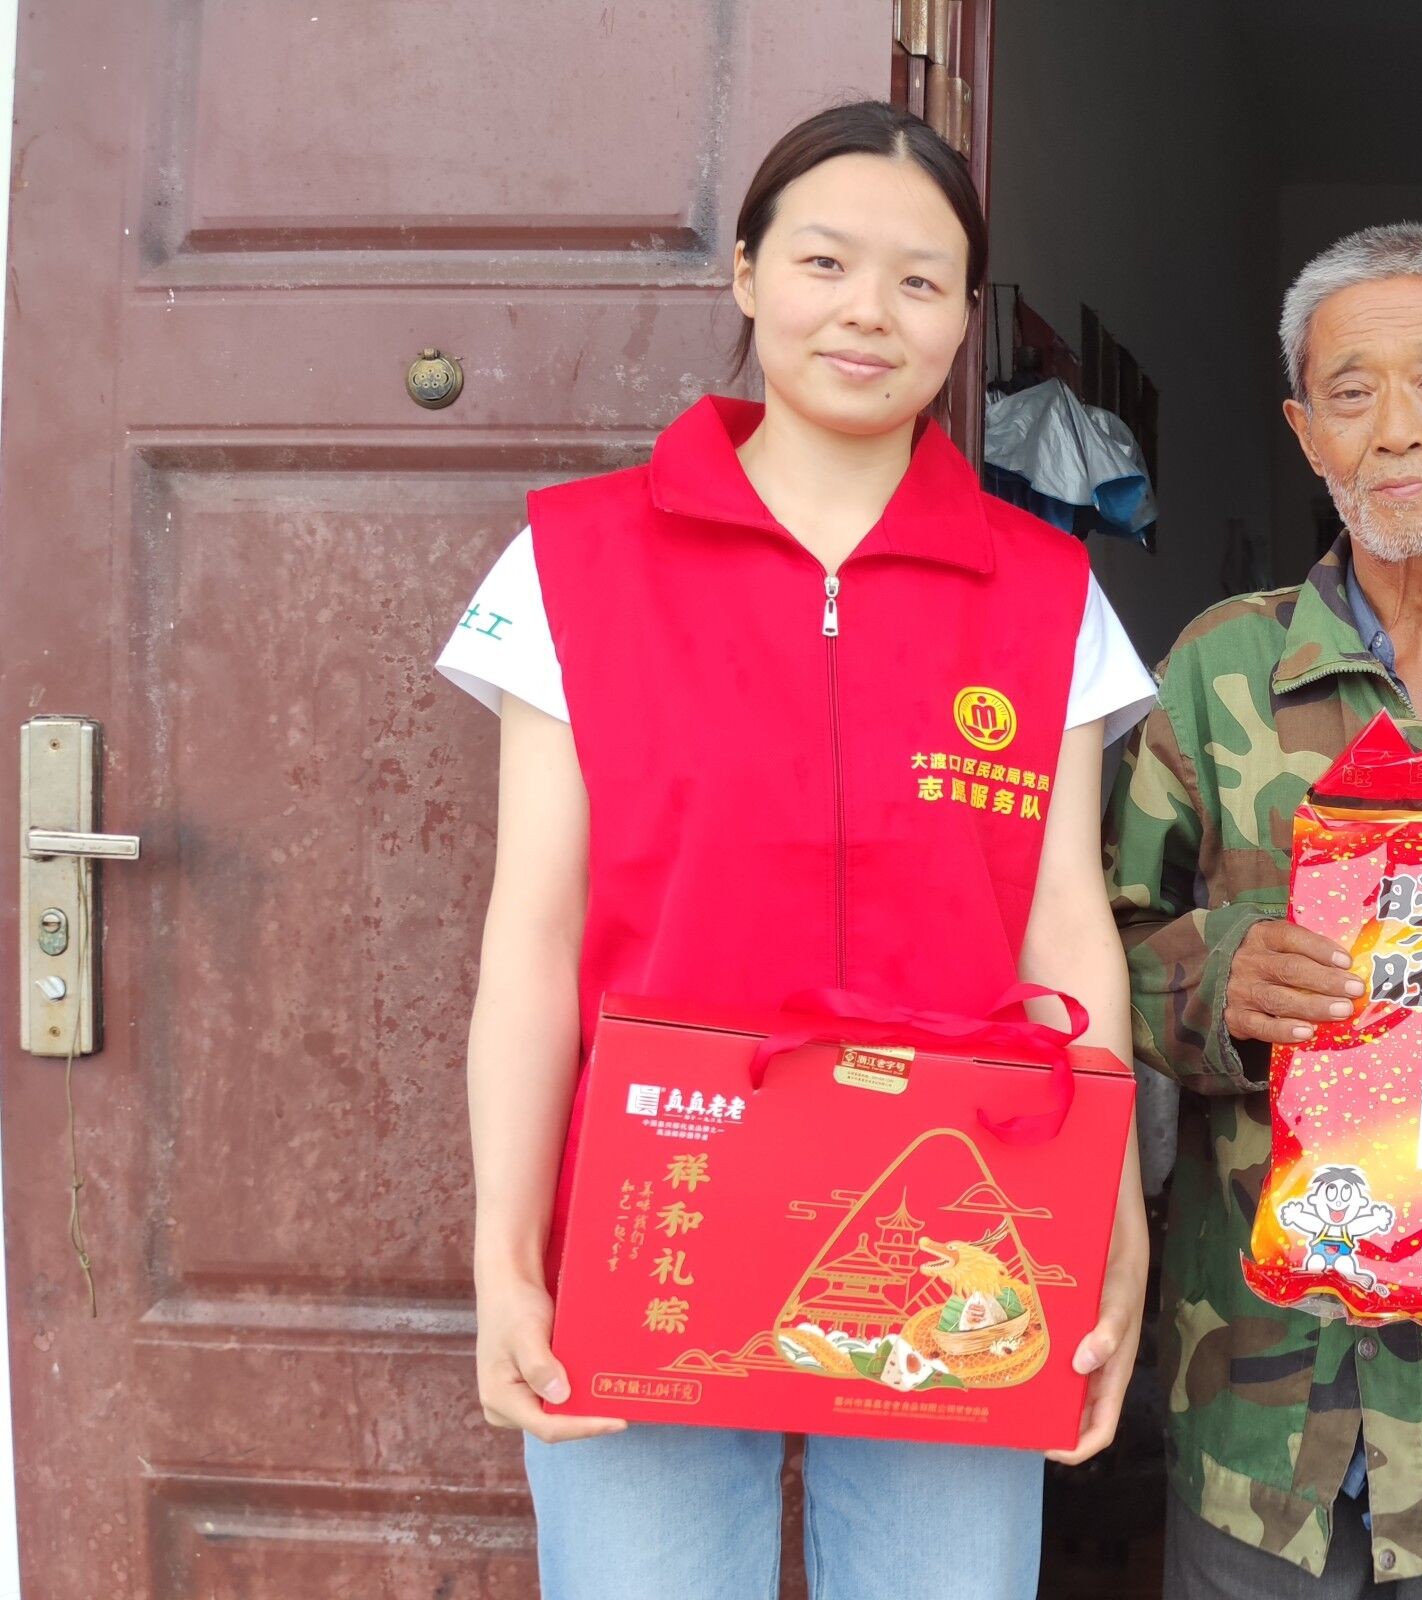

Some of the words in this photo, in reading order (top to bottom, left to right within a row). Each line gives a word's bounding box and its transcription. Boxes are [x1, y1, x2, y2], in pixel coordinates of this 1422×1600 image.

[911, 752, 1050, 792] 大渡口区民政局党员
[1342, 765, 1372, 788] 旺
[917, 775, 1041, 820] 志愿服务队
[664, 1088, 746, 1120] 真真老老
[642, 1153, 712, 1334] 祥和礼粽
